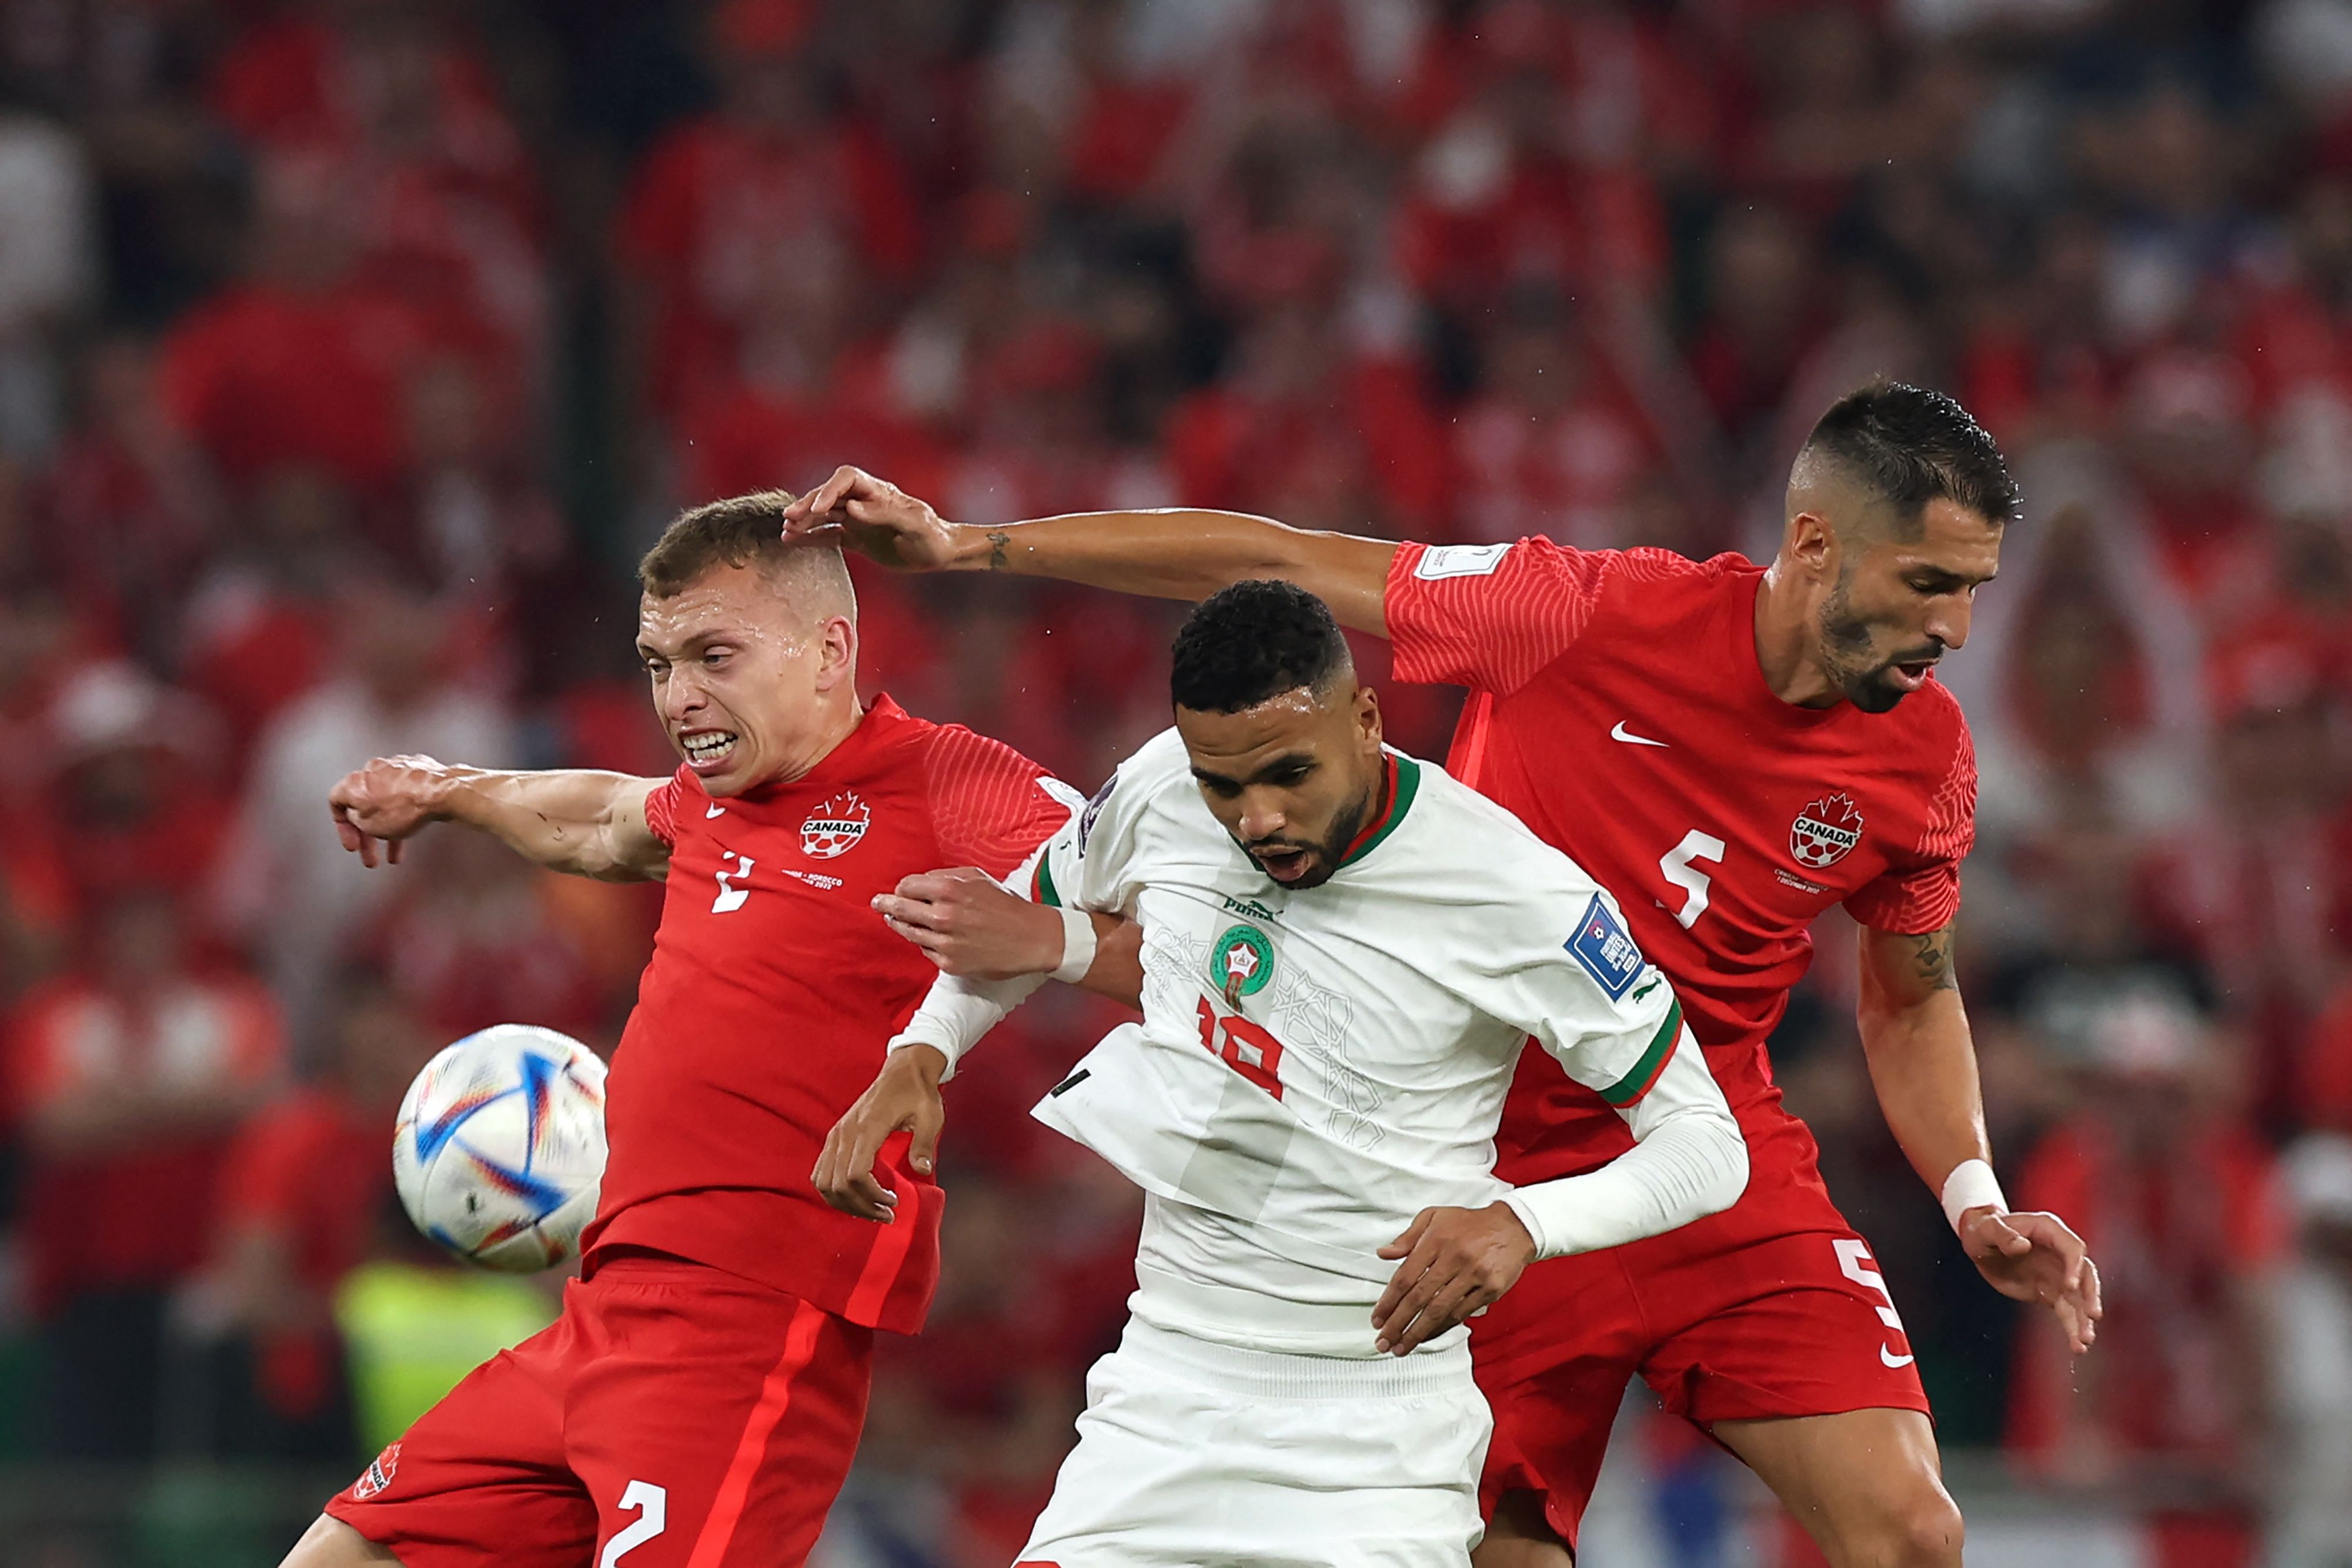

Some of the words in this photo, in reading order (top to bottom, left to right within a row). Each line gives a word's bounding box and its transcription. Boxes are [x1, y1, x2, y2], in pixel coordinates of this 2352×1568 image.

[803, 823, 862, 834] CANADA
[1795, 819, 1853, 845] CANADA
[711, 851, 756, 914] 2
[1656, 829, 1726, 930] 5
[1197, 994, 1284, 1103] 19
[1832, 1239, 1905, 1333] 5
[600, 1479, 666, 1568] 2
